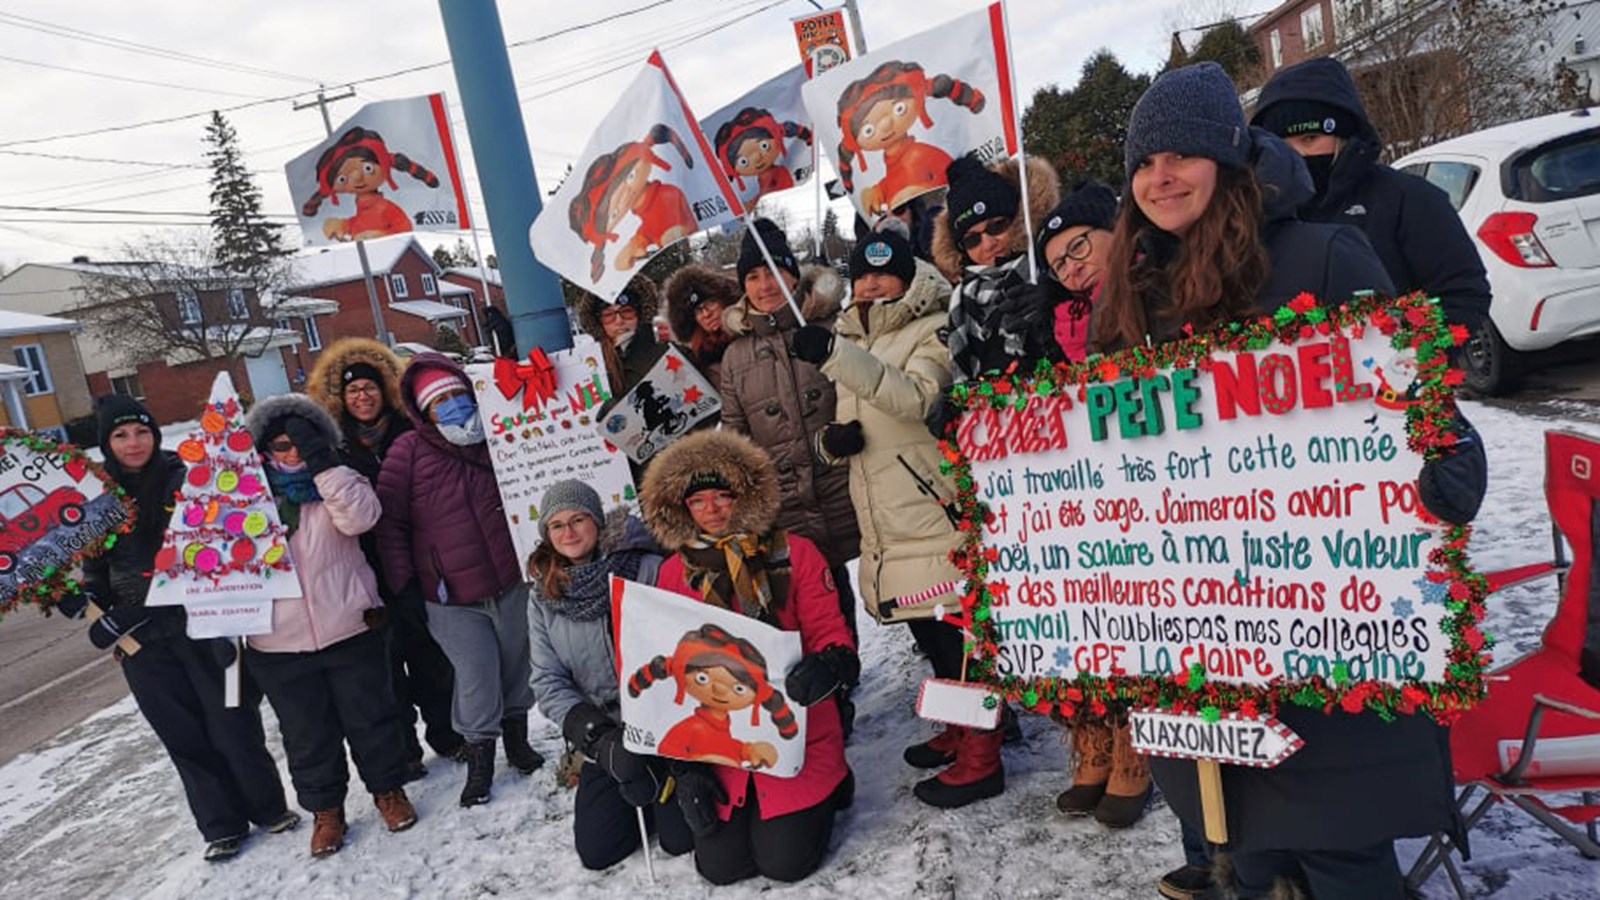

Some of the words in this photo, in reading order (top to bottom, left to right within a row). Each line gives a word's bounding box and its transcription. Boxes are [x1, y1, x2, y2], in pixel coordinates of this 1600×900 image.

[22, 451, 63, 482] CPE
[985, 469, 1014, 499] j'ai
[1023, 458, 1105, 494] travaillé
[1117, 453, 1157, 482] très
[1165, 445, 1212, 480] fort
[1228, 433, 1296, 473] cette
[1308, 425, 1397, 462] année
[1018, 501, 1052, 544] j'ai
[1058, 500, 1086, 528] été
[1093, 497, 1150, 533] sage.
[1288, 478, 1366, 519] avoir
[1378, 479, 1420, 525] po
[1041, 545, 1071, 570] un
[1077, 538, 1155, 569] salaire
[1162, 530, 1180, 564] à
[1185, 535, 1230, 564] ma
[1235, 529, 1313, 587] juste
[988, 577, 1010, 608] t
[1018, 575, 1057, 607] des
[1063, 571, 1177, 608] meilleures
[1182, 575, 1327, 613] conditions
[1340, 575, 1382, 613] de
[994, 609, 1078, 643] travail.
[1235, 619, 1281, 646] mes
[998, 643, 1044, 675] SVP.
